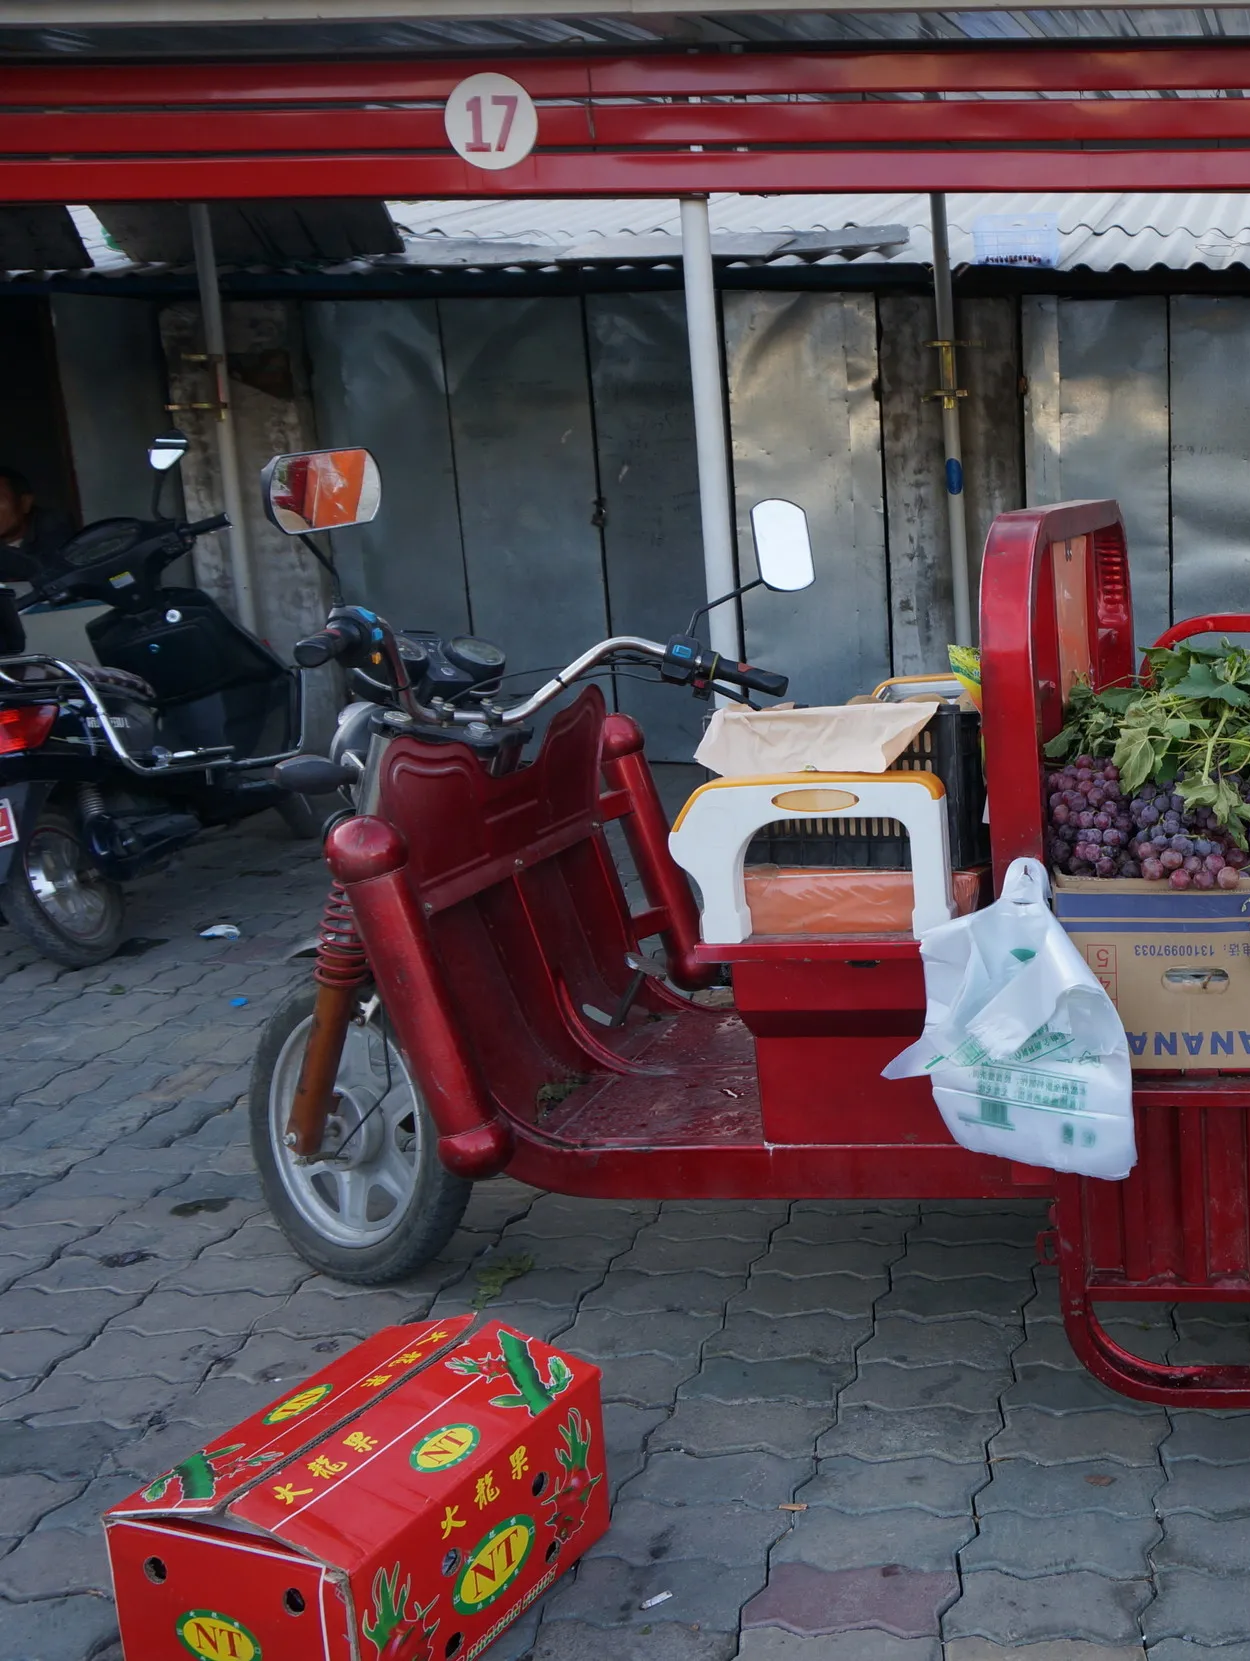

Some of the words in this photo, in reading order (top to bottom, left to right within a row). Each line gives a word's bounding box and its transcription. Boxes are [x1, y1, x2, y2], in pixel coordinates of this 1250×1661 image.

[465, 95, 518, 152] 17
[1096, 949, 1110, 968] 5
[272, 1431, 379, 1506] 火龍果
[420, 1430, 468, 1465] NT
[440, 1445, 529, 1540] 火龍果
[470, 1528, 519, 1600] NT
[192, 1621, 243, 1659] NT
